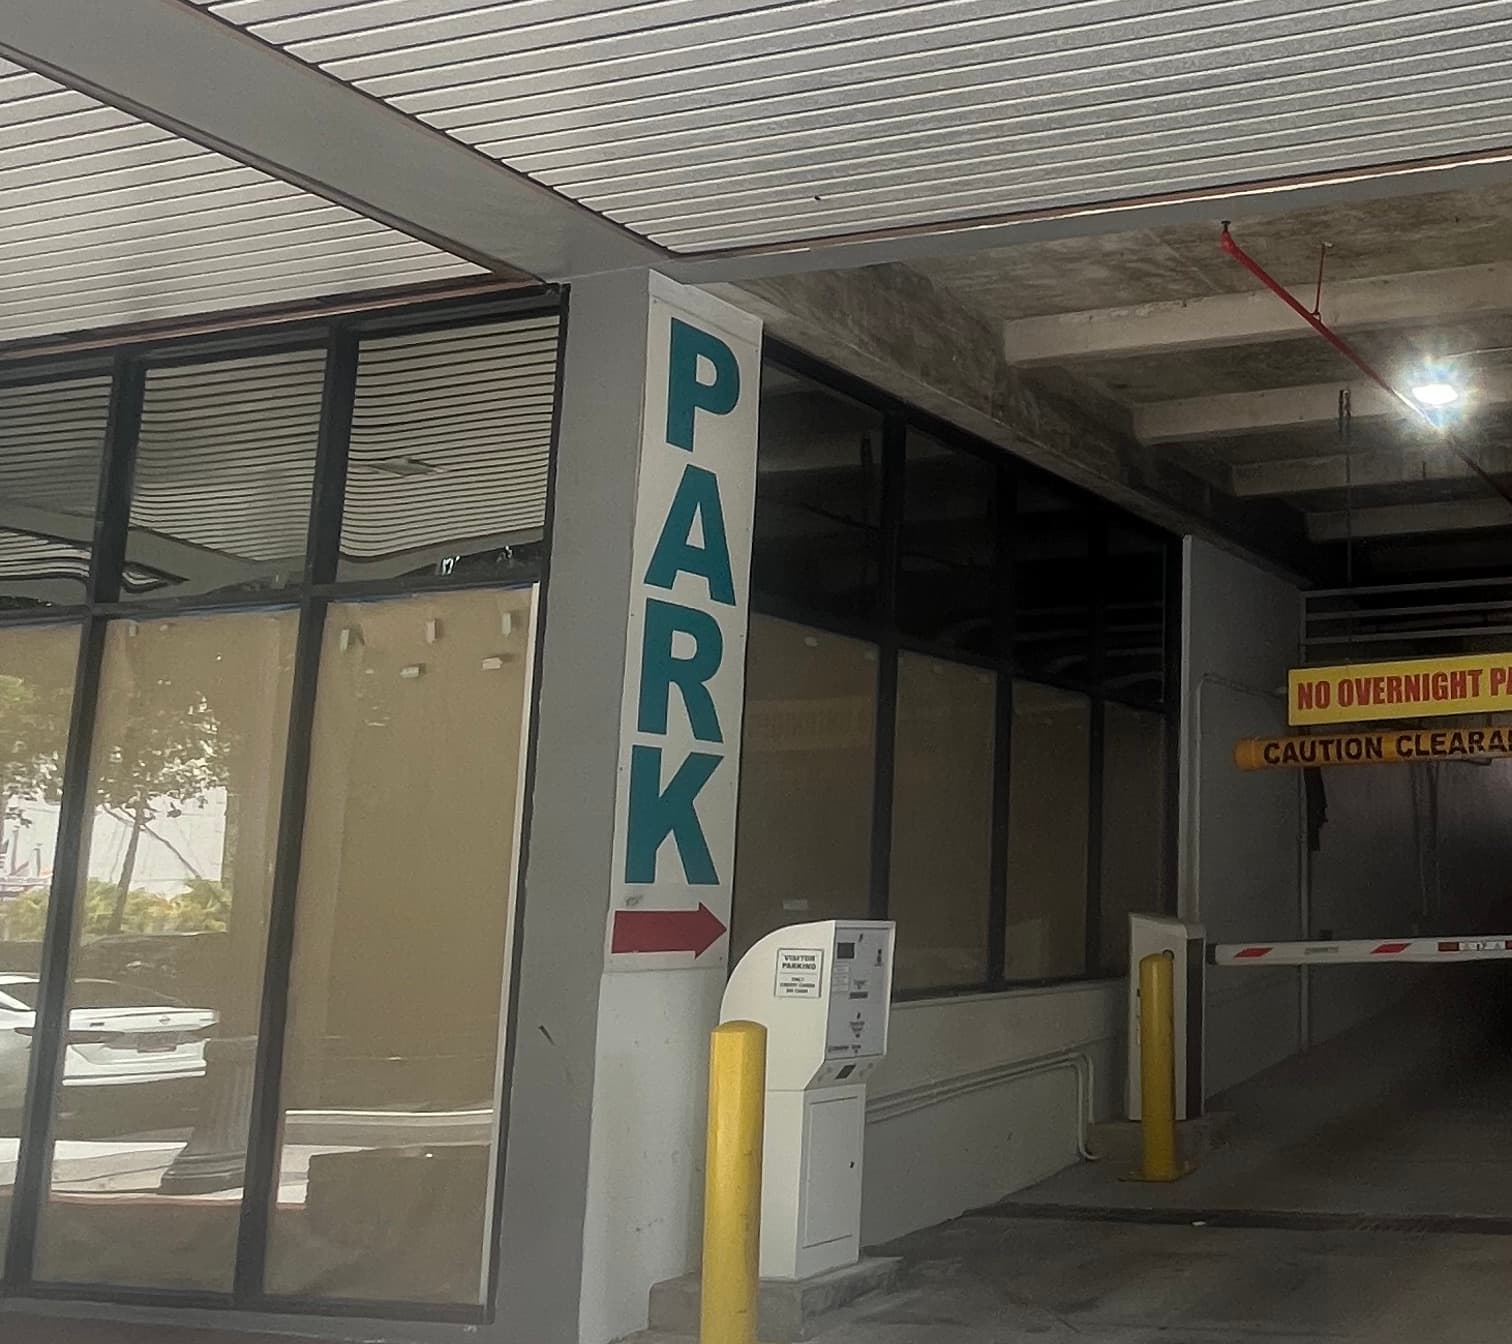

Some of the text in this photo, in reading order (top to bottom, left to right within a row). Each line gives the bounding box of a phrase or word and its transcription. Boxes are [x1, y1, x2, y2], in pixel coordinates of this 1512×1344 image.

[624, 316, 741, 885] PARK
[1297, 681, 1331, 711] NO
[1337, 669, 1483, 709] OVERNIGHT
[1263, 737, 1383, 766] CAUTION
